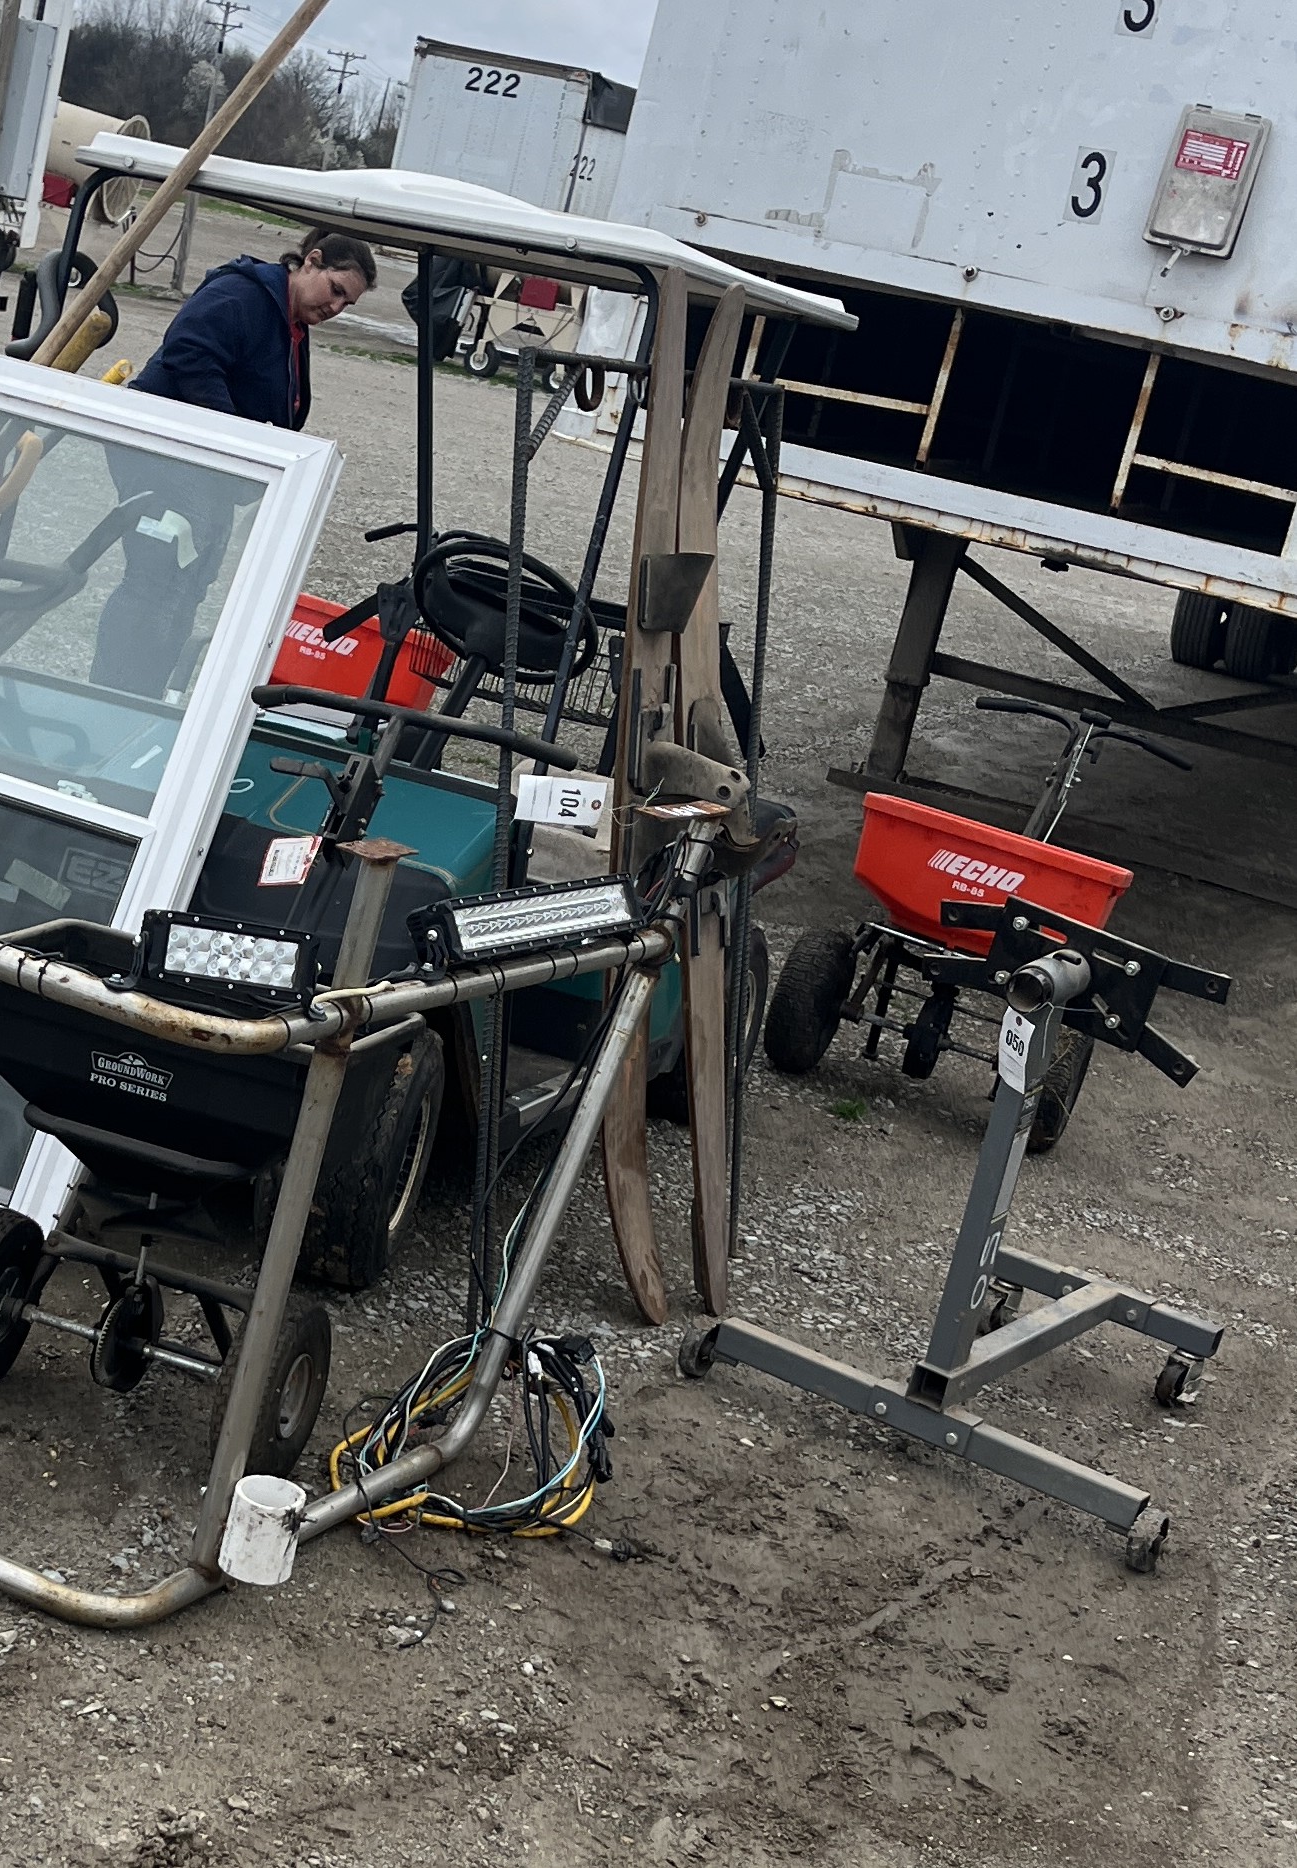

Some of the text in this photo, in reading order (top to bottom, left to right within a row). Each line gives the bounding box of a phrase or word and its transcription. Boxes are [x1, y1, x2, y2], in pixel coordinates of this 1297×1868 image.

[465, 67, 521, 98] 222
[1071, 152, 1106, 217] 3
[558, 788, 582, 818] 104
[945, 853, 1026, 893] ECHO
[1005, 1029, 1025, 1057] 050
[89, 1072, 168, 1103] PRO SERIES
